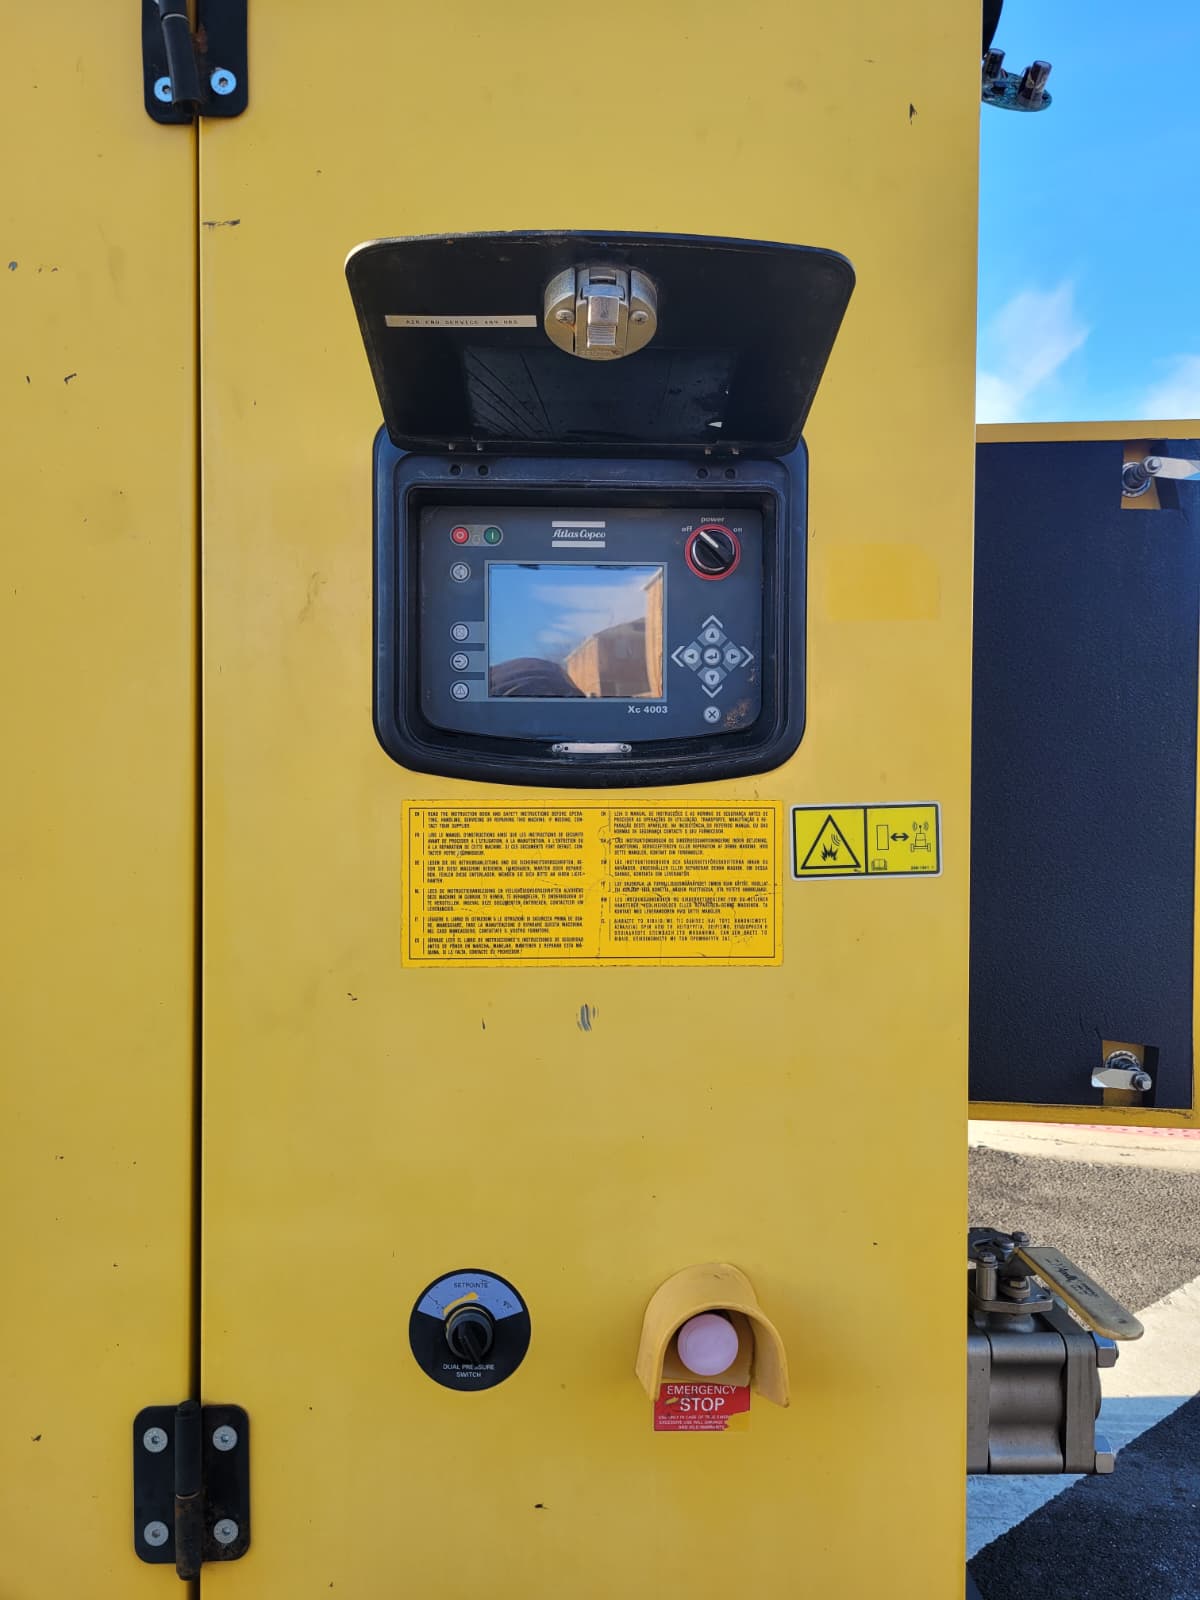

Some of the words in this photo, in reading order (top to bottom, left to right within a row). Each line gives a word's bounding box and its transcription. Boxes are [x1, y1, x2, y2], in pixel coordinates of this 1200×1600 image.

[552, 529, 579, 538] Atlas
[579, 529, 606, 541] Copco
[628, 705, 641, 714] Xc
[643, 705, 668, 714] 4003
[667, 1386, 736, 1395] EMERGENCY
[680, 1398, 724, 1412] STOP
